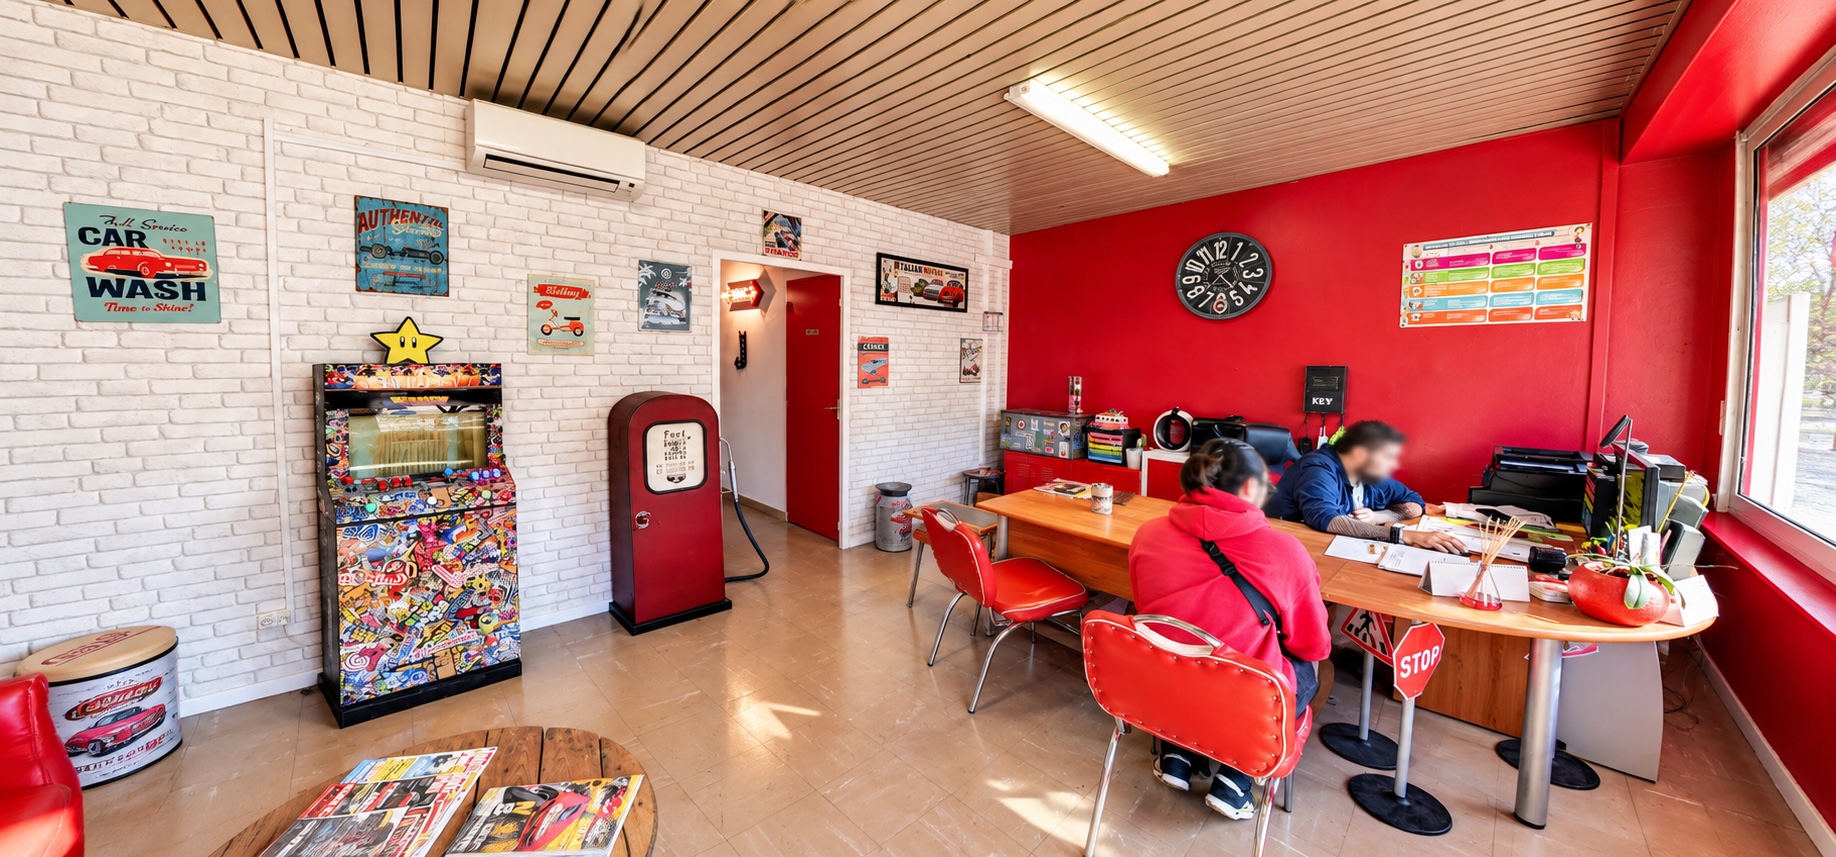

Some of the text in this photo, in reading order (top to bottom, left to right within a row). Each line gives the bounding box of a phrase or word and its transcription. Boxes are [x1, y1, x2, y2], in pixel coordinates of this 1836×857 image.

[78, 227, 149, 249] CAR
[1196, 246, 1214, 265] 11
[1214, 240, 1228, 260] 12
[1231, 242, 1243, 261] 1
[1185, 259, 1206, 273] 10
[1239, 252, 1259, 268] 2
[1182, 274, 1201, 285] 9
[1242, 268, 1264, 279] 3
[86, 276, 207, 301] WASH
[1186, 285, 1205, 299] 8
[1238, 281, 1258, 295] 4
[1198, 291, 1215, 308] 7
[1229, 289, 1244, 306] 5
[104, 302, 137, 312] Time
[153, 303, 195, 312] Shine!
[1312, 397, 1333, 405] KEY
[1400, 645, 1439, 678] STOP
